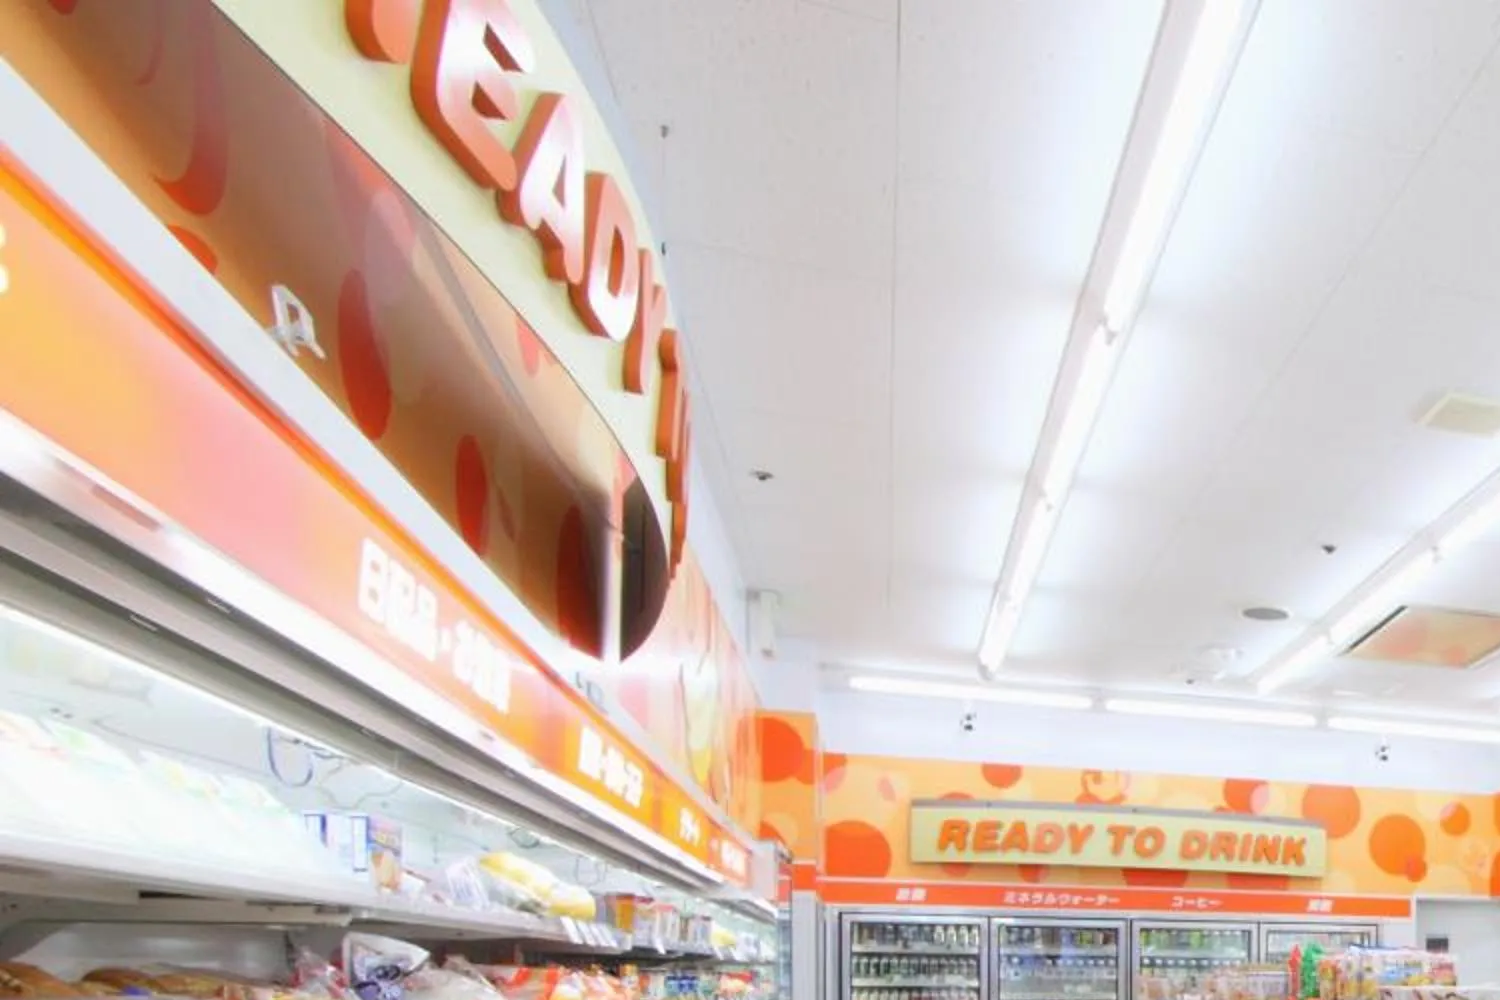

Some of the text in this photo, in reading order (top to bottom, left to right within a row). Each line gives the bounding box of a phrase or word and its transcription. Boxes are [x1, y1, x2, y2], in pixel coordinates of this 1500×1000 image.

[345, 0, 665, 394] EADY
[937, 818, 1308, 866] READY TO DRINK
[1171, 895, 1223, 909] コーヒー
